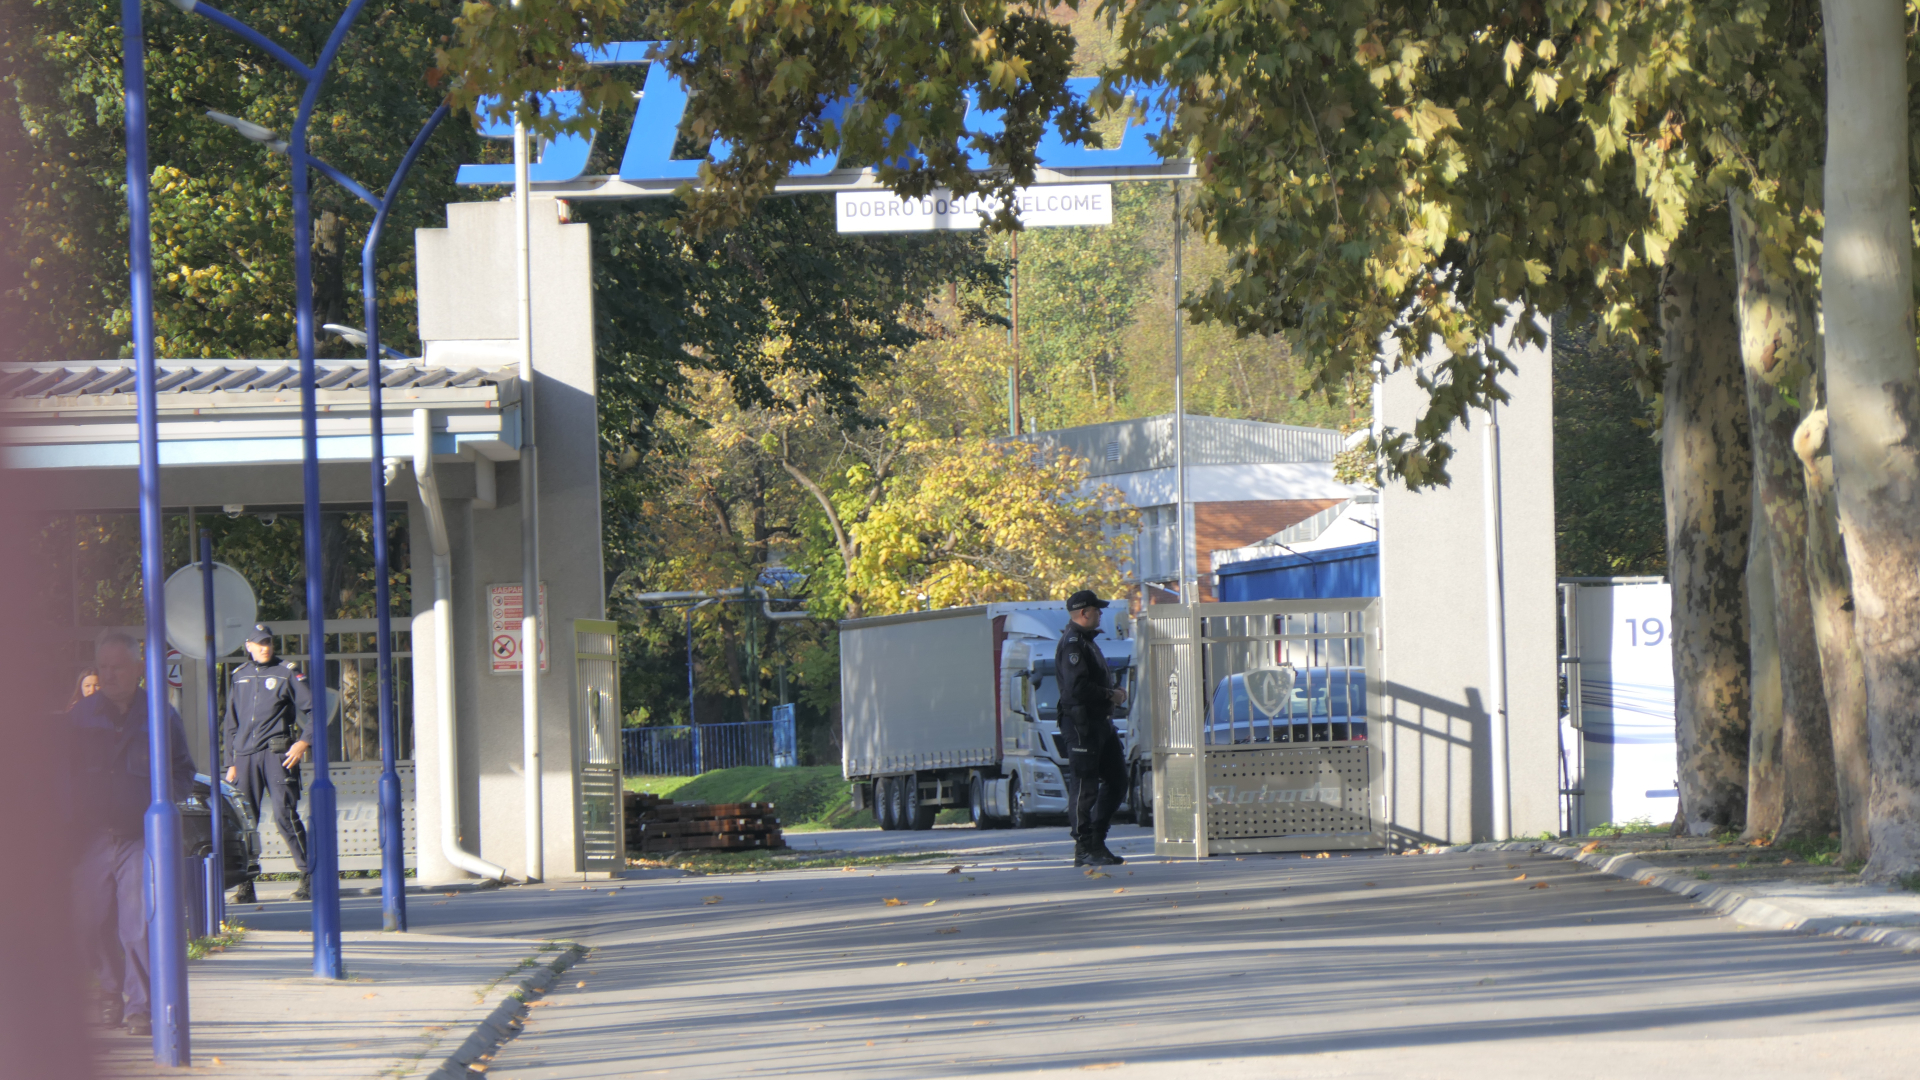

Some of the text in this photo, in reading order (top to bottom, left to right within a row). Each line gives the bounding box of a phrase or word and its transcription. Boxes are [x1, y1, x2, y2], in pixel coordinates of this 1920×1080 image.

[845, 199, 914, 218] DOBRO
[1013, 194, 1103, 212] ELCOME
[1625, 617, 1673, 647] 19
